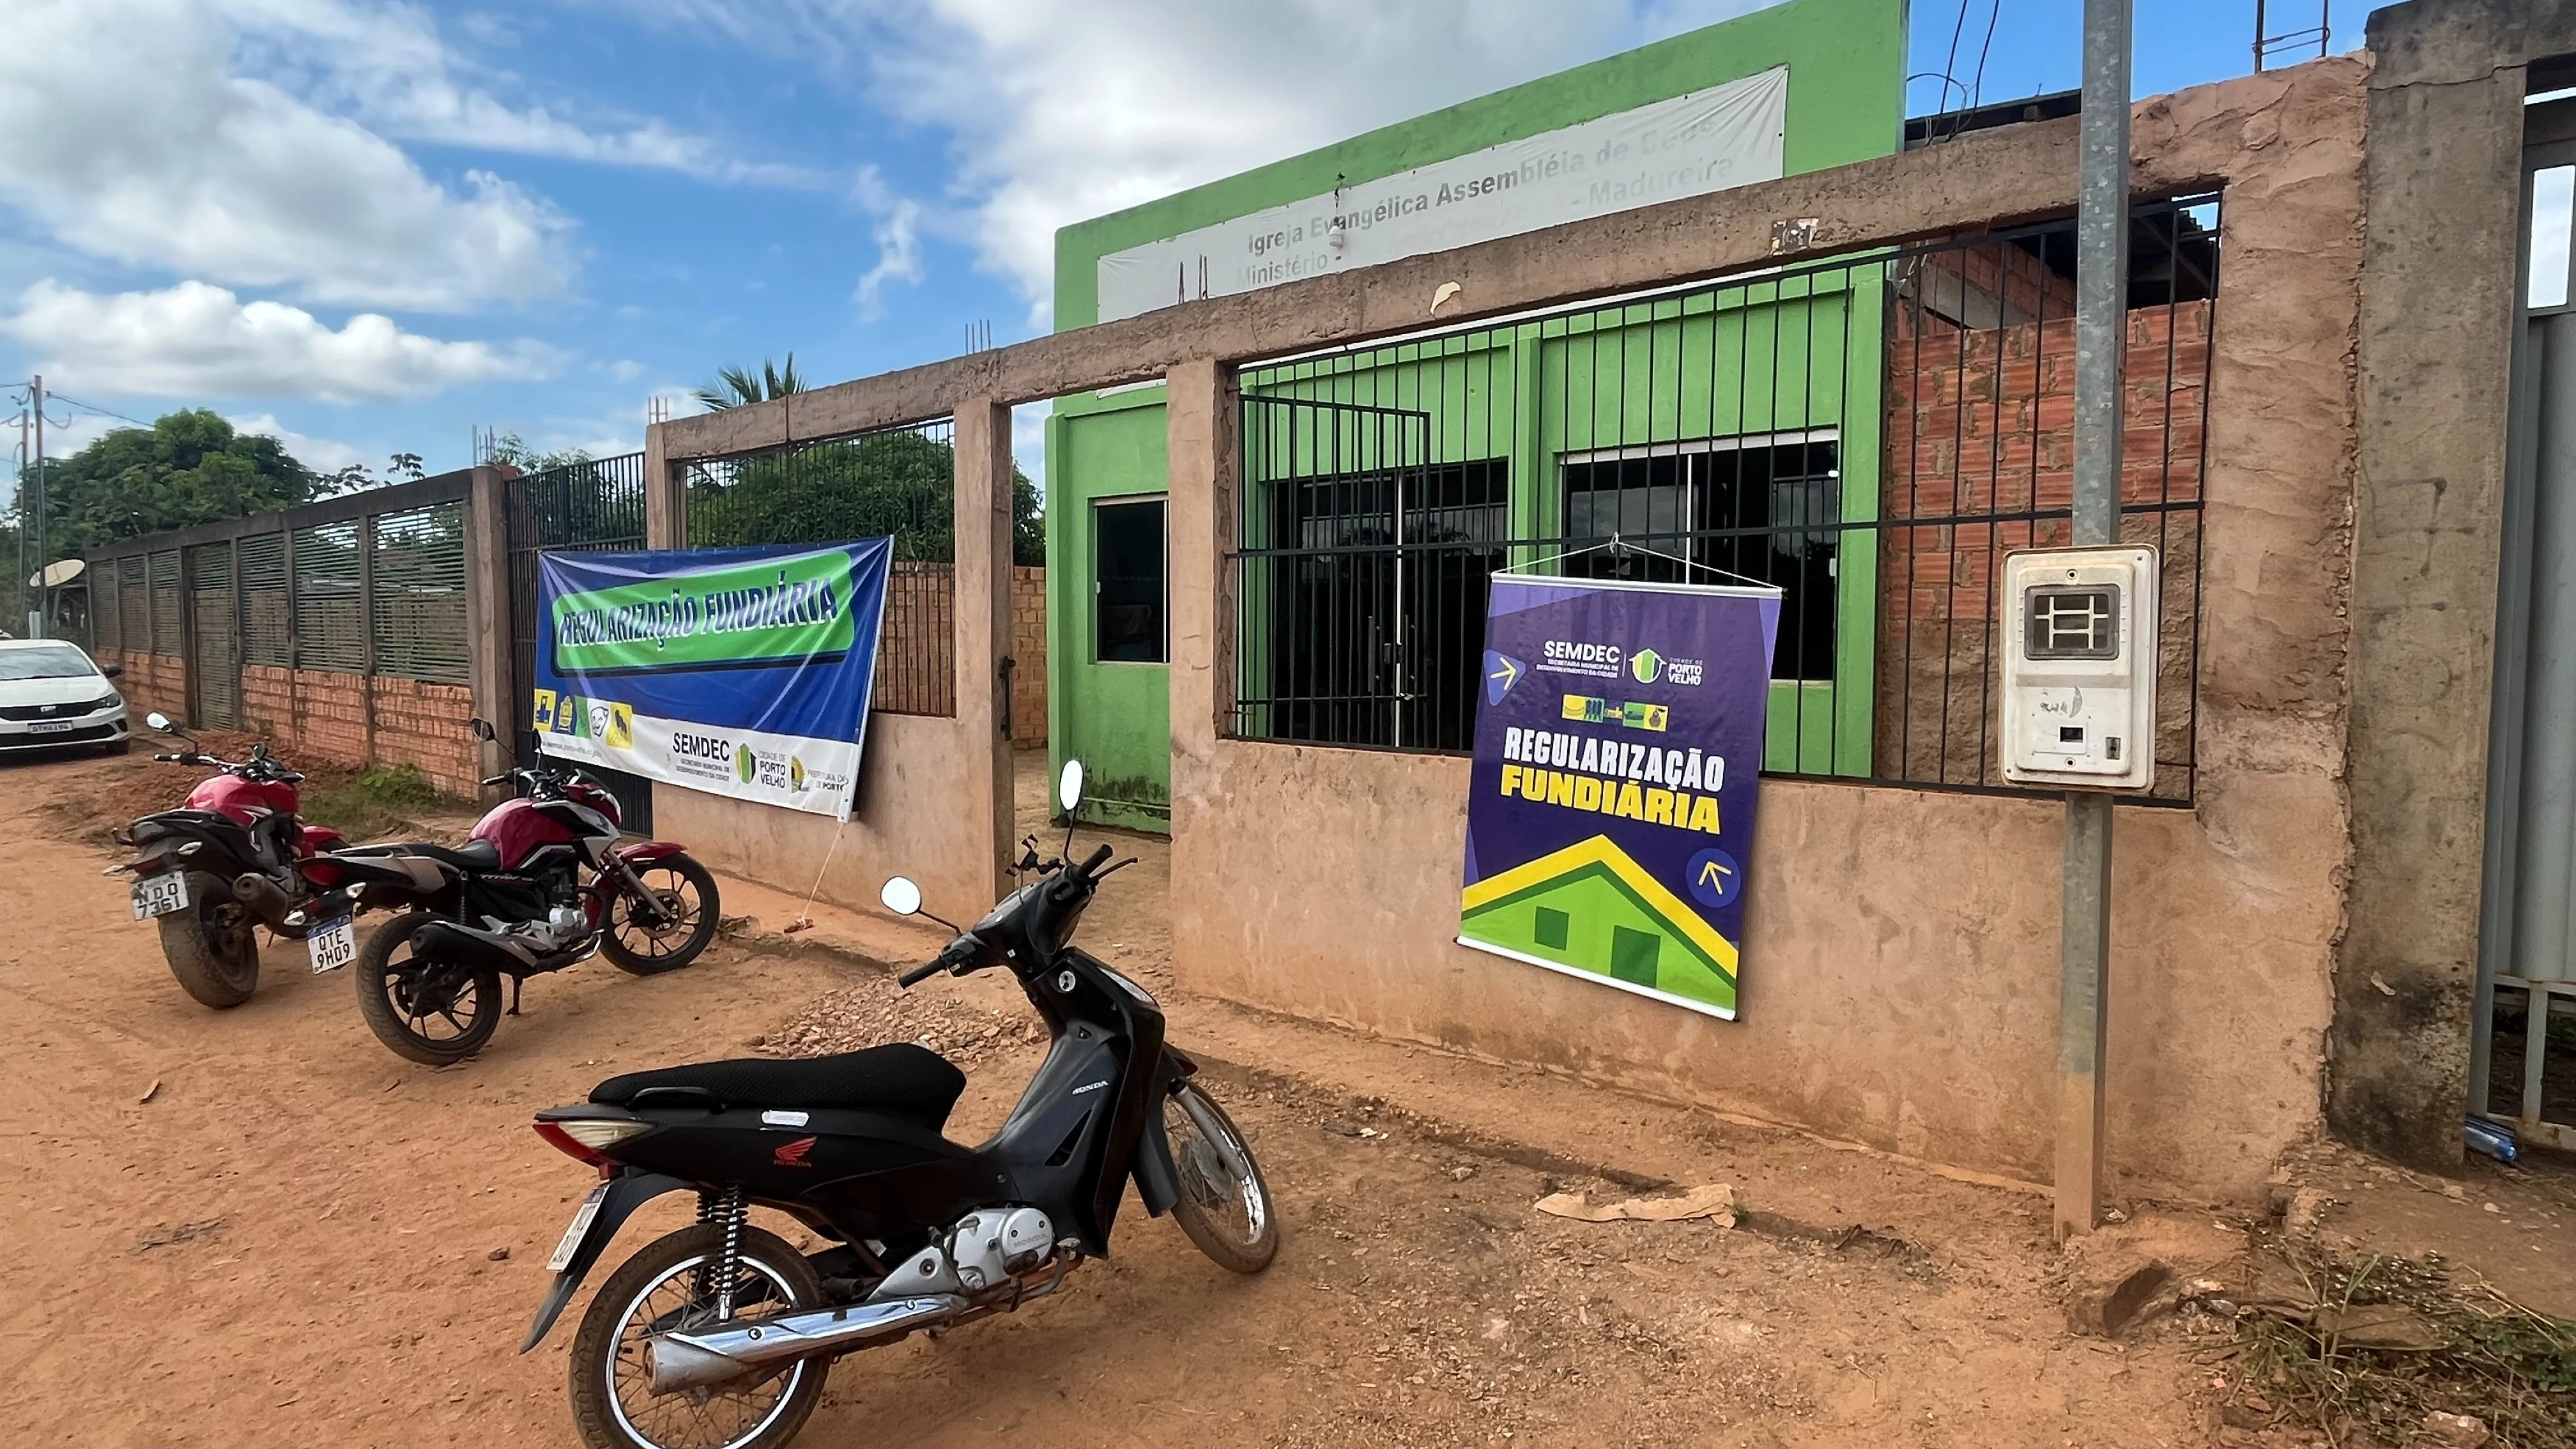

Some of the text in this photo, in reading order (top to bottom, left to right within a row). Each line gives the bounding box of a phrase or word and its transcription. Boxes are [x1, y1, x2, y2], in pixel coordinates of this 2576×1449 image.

[1589, 157, 1732, 207] Madureira
[1248, 226, 1303, 256] Igreja
[1310, 194, 1428, 238] Evangélica
[1436, 151, 1586, 207] Assembléia
[1597, 140, 1629, 165] de
[1238, 251, 1328, 288] Ministério
[558, 571, 838, 652] REGULARIZAÇÃO FUNDIÁRIA
[1544, 640, 1620, 663] SEMDEC
[1668, 672, 1702, 686] VELHO
[1669, 663, 1703, 676] PORTO
[673, 733, 730, 762] SEMDEC
[1503, 726, 1725, 792] REGULARIZAÇÃO
[760, 760, 786, 776] PORTO
[760, 773, 786, 788] VELHO
[1501, 763, 1721, 835] FUNDIÁRIA
[138, 895, 180, 918] 7361
[318, 943, 350, 969] 9H09
[1072, 1080, 1109, 1095] HONDA
